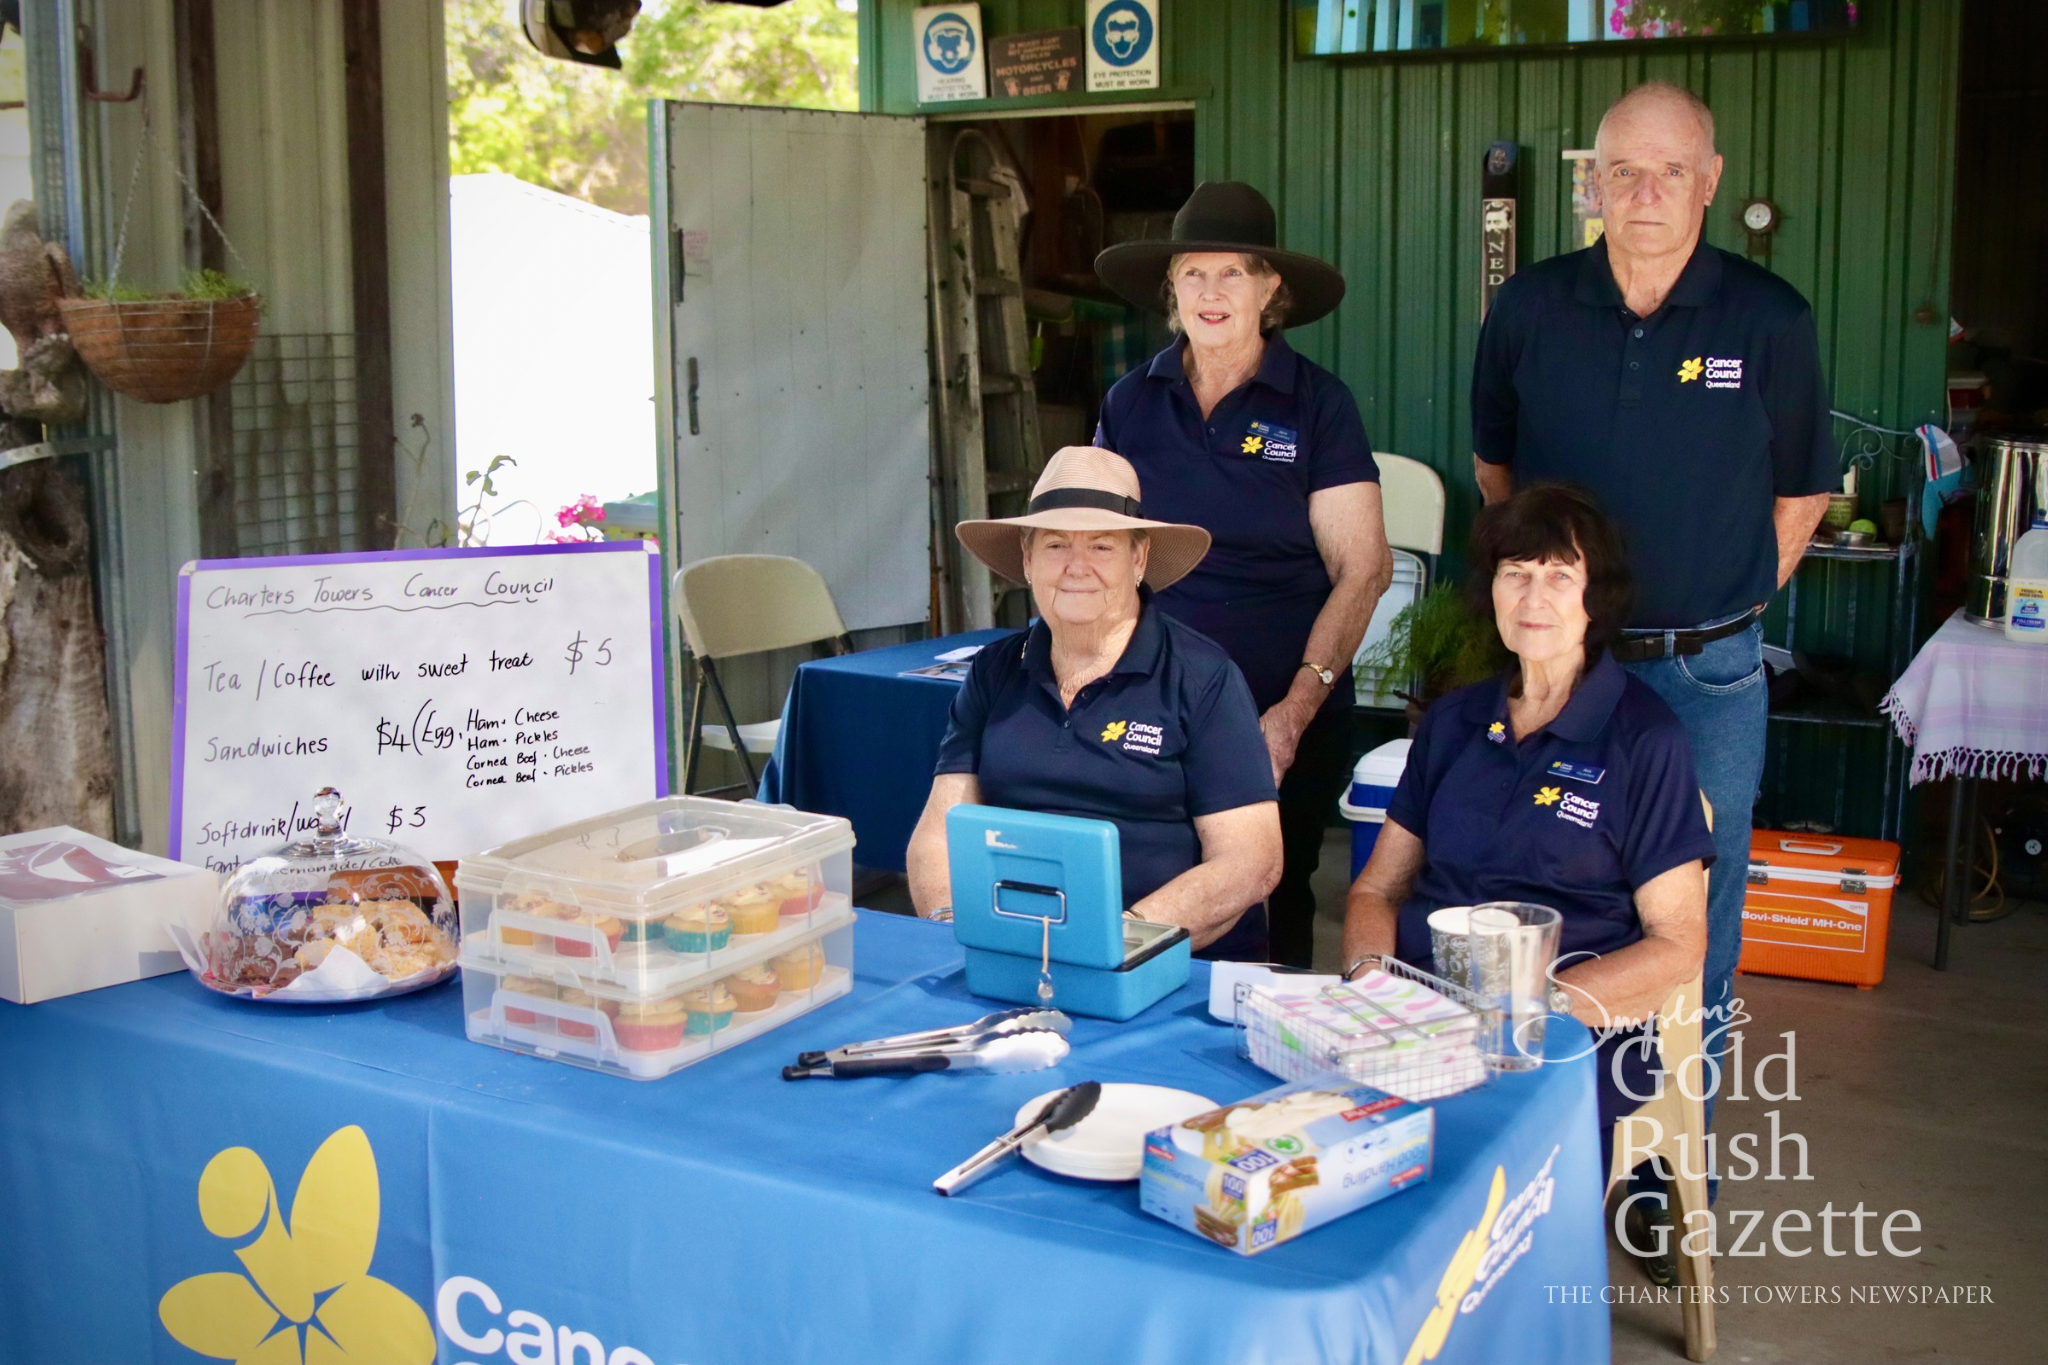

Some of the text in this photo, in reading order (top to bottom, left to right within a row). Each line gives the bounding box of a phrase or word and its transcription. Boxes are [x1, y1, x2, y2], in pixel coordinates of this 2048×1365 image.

[996, 56, 1078, 77] MOTORCYCLES
[1109, 69, 1151, 78] PROTECTION
[932, 84, 972, 92] PROTECTION
[1023, 84, 1052, 96] BEER
[1705, 357, 1742, 368] Cancer
[1705, 367, 1742, 379] Council
[1705, 380, 1741, 388] Queensland
[1264, 447, 1296, 458] Council
[1266, 440, 1297, 451] Cancer
[206, 571, 553, 609] Charters Towers Cancer Council
[203, 660, 242, 692] Tea
[361, 664, 400, 681] with
[417, 653, 469, 678] sweet
[489, 650, 534, 672] treat
[204, 735, 328, 762] Sandwiches
[515, 707, 560, 726] Cheese
[1129, 721, 1163, 735] Cancer
[515, 730, 559, 745] Pickles
[1126, 731, 1163, 746] Council
[1123, 742, 1160, 755] Queensland
[467, 745, 590, 770] Corned Beef Cheese
[466, 761, 594, 788] Corned Beef Pickles
[1563, 791, 1600, 810] Cancer
[1560, 800, 1599, 820] Council
[1741, 910, 1863, 931] Bovi-Shield MH-One
[1223, 1173, 1245, 1194] 100
[1491, 1144, 1561, 1240] Cancer
[1474, 1177, 1555, 1282] Council
